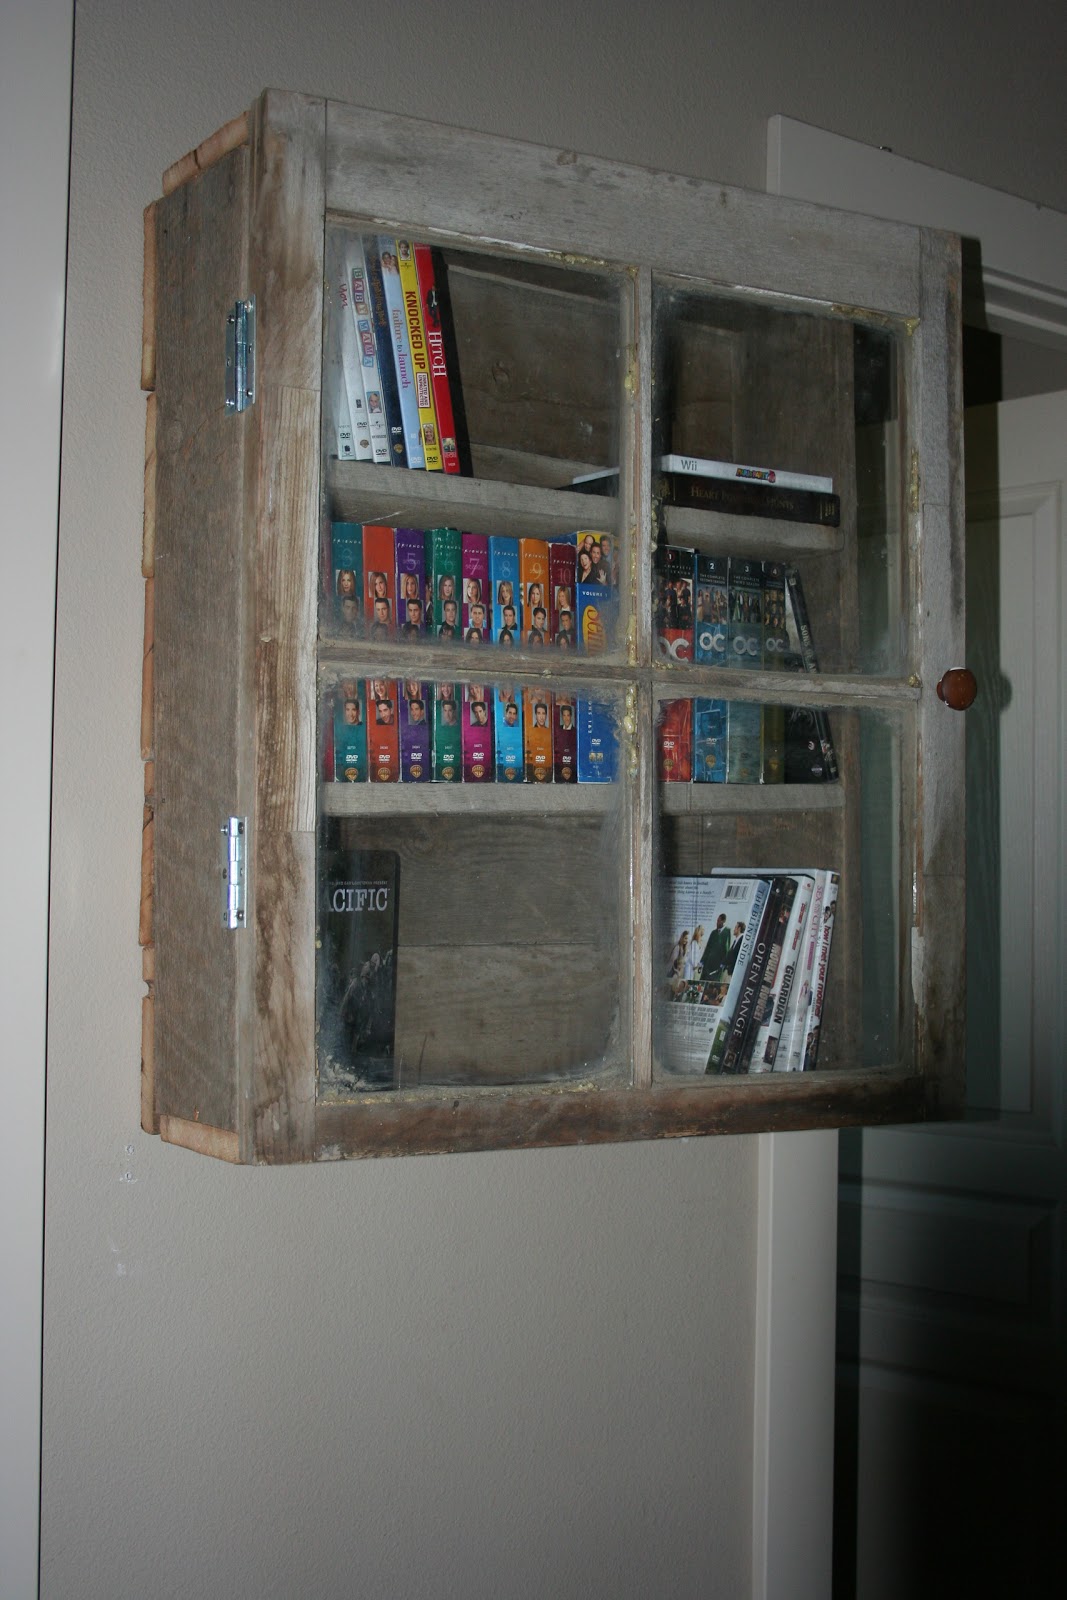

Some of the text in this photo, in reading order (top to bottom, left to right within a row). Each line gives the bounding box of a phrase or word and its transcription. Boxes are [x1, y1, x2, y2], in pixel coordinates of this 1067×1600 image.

[353, 268, 375, 367] BABY MAMA
[405, 291, 426, 370] KNOCKED UP
[392, 309, 403, 341] failure
[398, 353, 411, 389] launch
[428, 331, 447, 377] HITCH
[681, 459, 697, 471] Wii
[407, 553, 416, 570] 5
[469, 558, 480, 576] 7
[502, 560, 512, 578] 8
[532, 563, 542, 579] 9
[559, 568, 571, 585] 10
[658, 636, 690, 662] OC
[700, 632, 725, 652] OC
[733, 635, 758, 656] OC
[766, 637, 784, 652] OC
[664, 741, 675, 749] DVD
[346, 754, 358, 762] DVD
[378, 754, 390, 762] DVD
[411, 752, 423, 760] DVD
[472, 752, 484, 760] DVD
[815, 885, 824, 901] SEX
[737, 889, 765, 967] THE BLIND SIDE
[810, 915, 819, 940] CITY
[823, 925, 831, 942] how
[820, 946, 828, 962] met
[818, 962, 826, 983] your
[733, 943, 766, 1037] OPEN RANGE
[774, 965, 794, 1024] GUARDIAN
